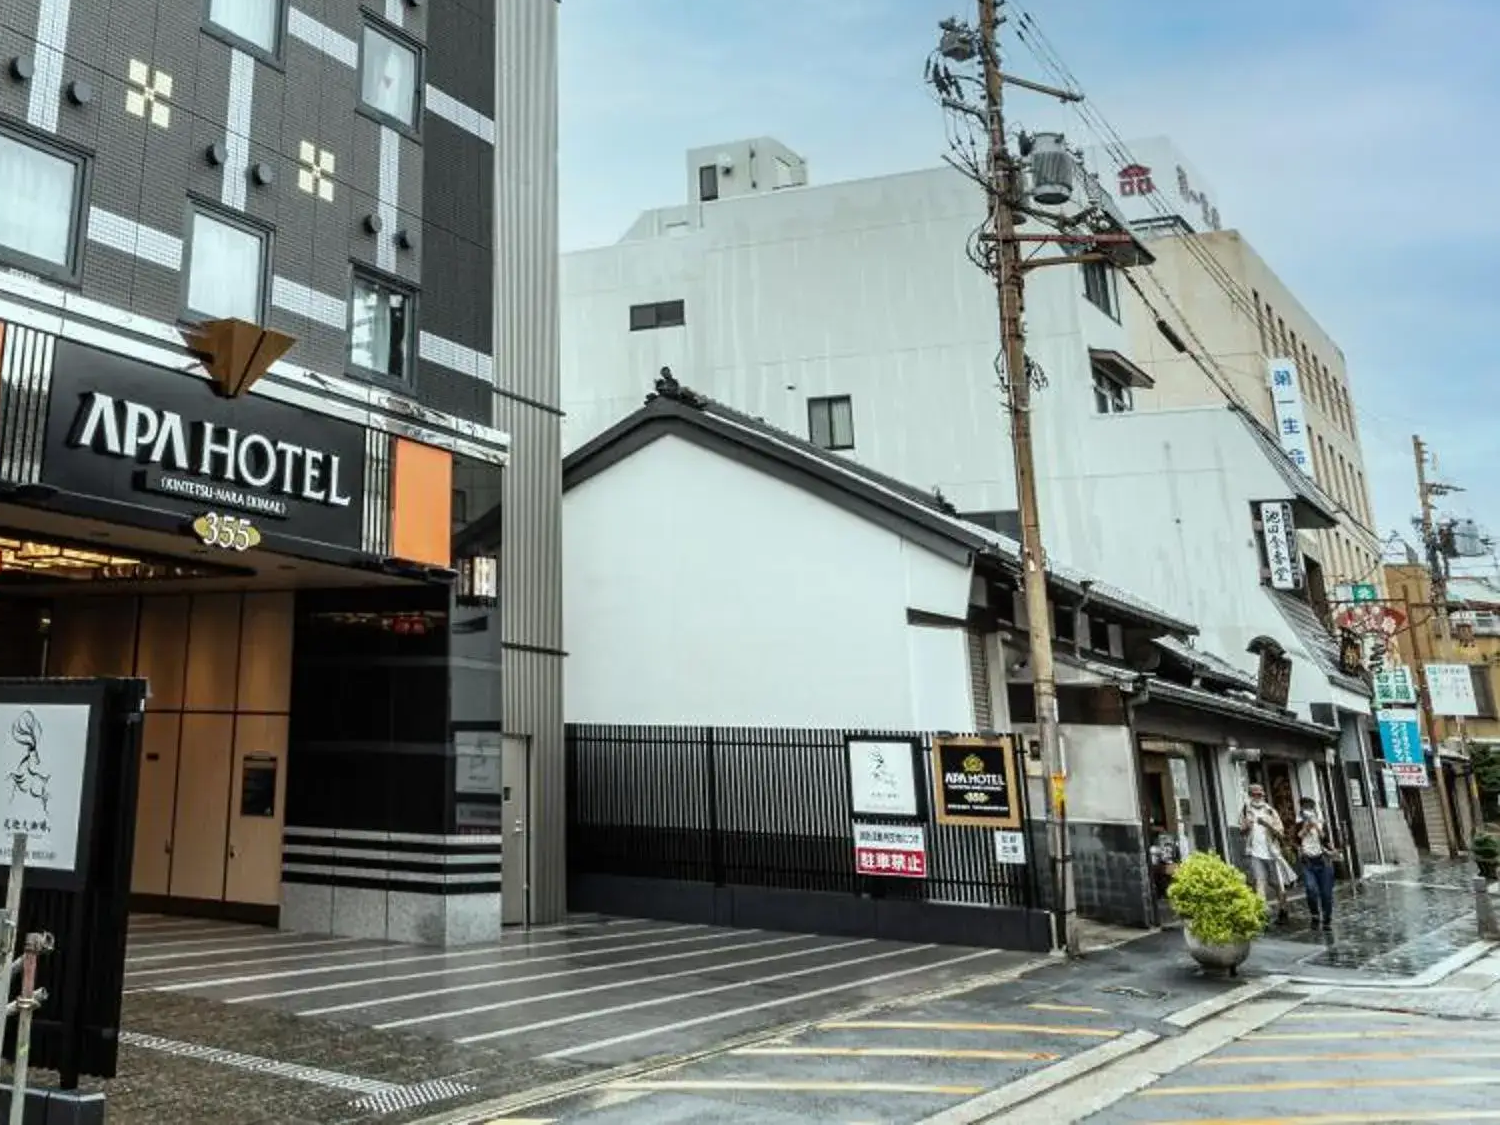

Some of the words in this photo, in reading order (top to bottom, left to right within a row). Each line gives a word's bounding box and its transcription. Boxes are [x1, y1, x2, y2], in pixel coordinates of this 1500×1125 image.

[80, 391, 188, 470] APA
[200, 422, 351, 507] HOTEL
[203, 512, 251, 552] 355
[967, 774, 1006, 786] HOTEL
[860, 851, 923, 873] 駐車禁止
